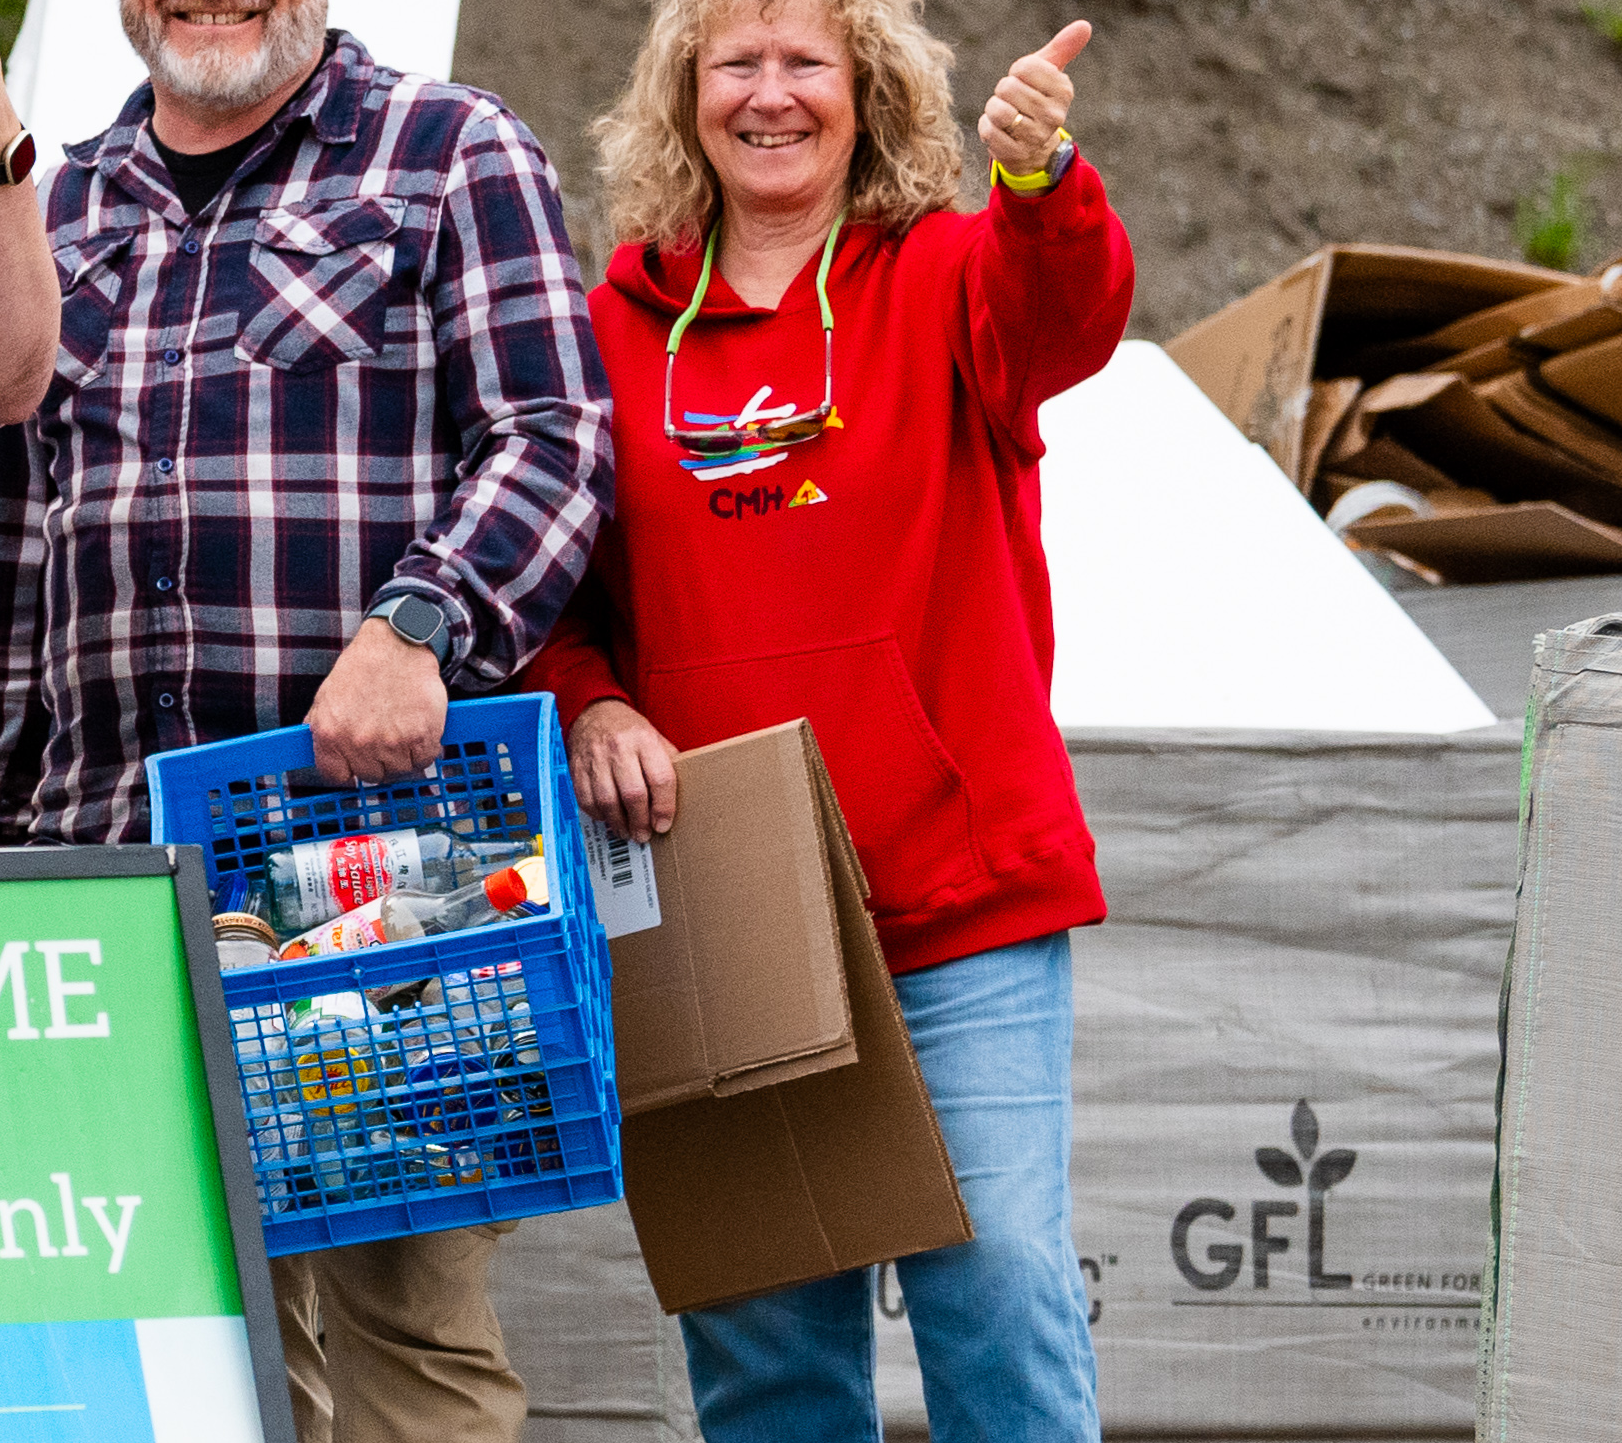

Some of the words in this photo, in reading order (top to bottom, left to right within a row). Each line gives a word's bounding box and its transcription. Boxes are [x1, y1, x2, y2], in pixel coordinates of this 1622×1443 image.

[709, 484, 784, 520] CMH
[344, 840, 357, 860] Soy
[349, 862, 363, 905] Sauce
[1170, 1187, 1354, 1292] GFL
[1361, 1271, 1431, 1290] GREEN
